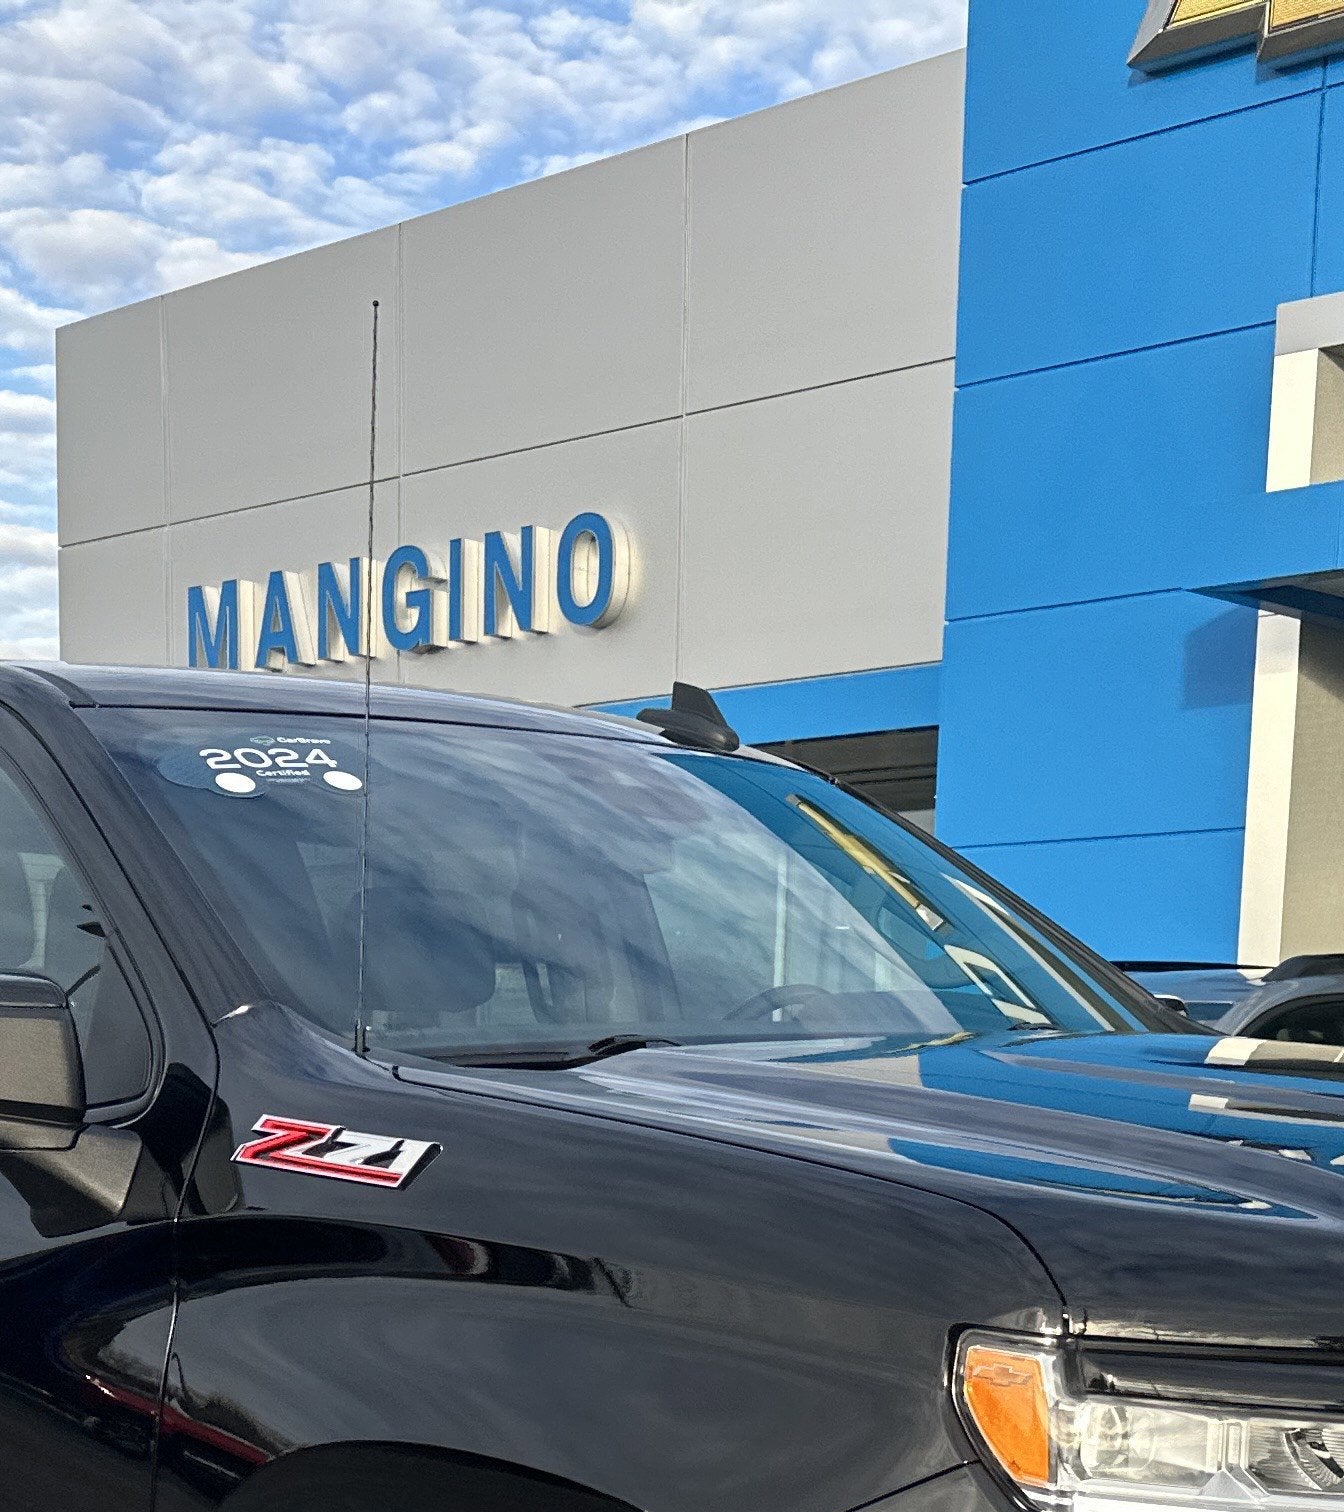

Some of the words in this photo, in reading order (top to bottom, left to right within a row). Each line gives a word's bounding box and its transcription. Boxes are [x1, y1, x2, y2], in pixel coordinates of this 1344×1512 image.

[187, 512, 622, 670] MANGINO
[199, 747, 338, 769] 2024
[256, 769, 311, 777] Certified
[230, 1114, 444, 1189] Z71
